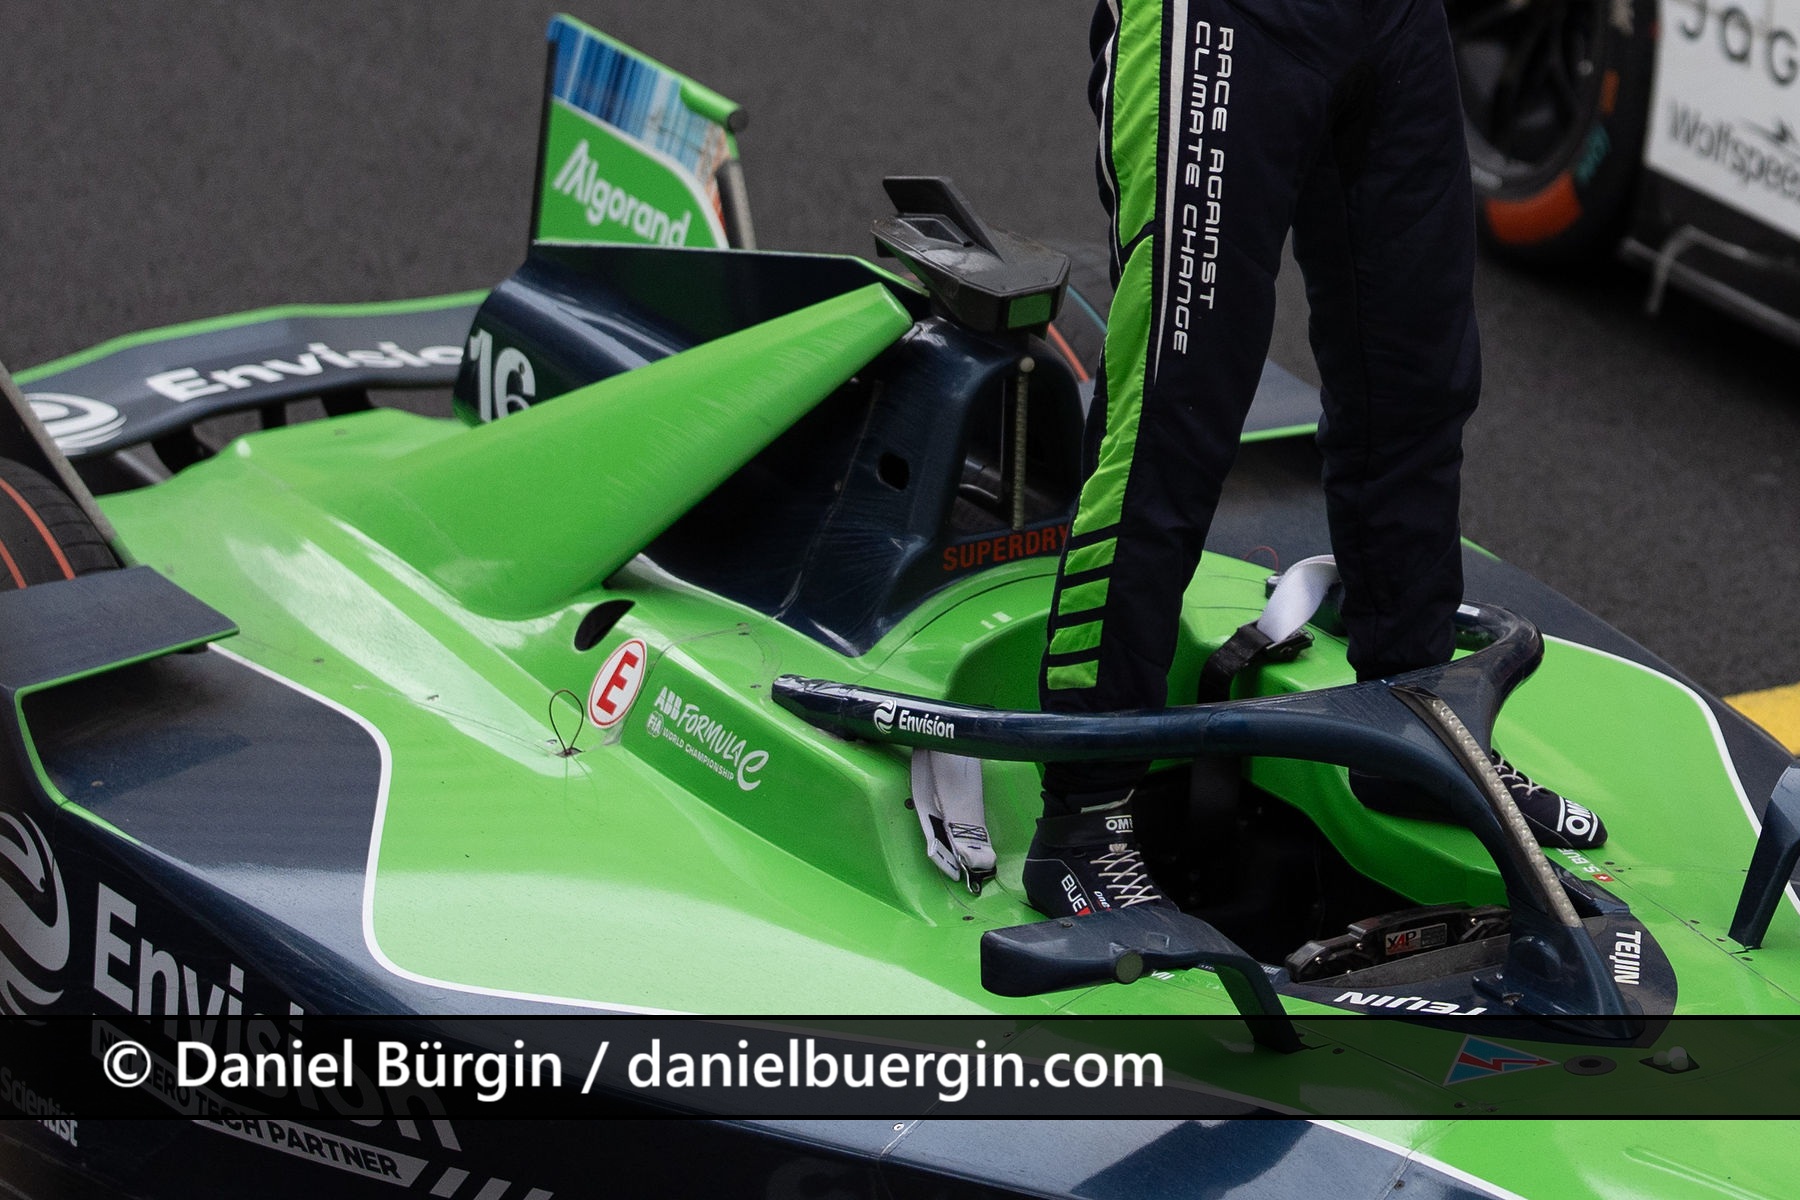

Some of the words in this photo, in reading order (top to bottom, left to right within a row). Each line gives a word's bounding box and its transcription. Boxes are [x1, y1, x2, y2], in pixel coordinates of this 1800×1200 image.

[1185, 20, 1211, 188] CLIMATE
[1211, 26, 1234, 132] RACE
[553, 139, 694, 248] Algorand
[1200, 148, 1225, 310] AGAINST
[1173, 203, 1198, 355] CHANGE
[146, 340, 464, 403] Envisio
[468, 327, 537, 424] 16
[942, 524, 1070, 572] SUPERDRY
[597, 650, 639, 715] E
[662, 726, 686, 749] WORLD
[685, 743, 735, 782] CHAMPIONSHIP
[676, 703, 748, 768] FORMULA
[898, 709, 955, 740] Envision
[1105, 817, 1134, 831] OM
[1061, 873, 1088, 913] BUE
[1608, 930, 1642, 986] TEIJIN
[1333, 991, 1488, 1016] TEIJIN
[268, 1122, 403, 1180] PARTNER
